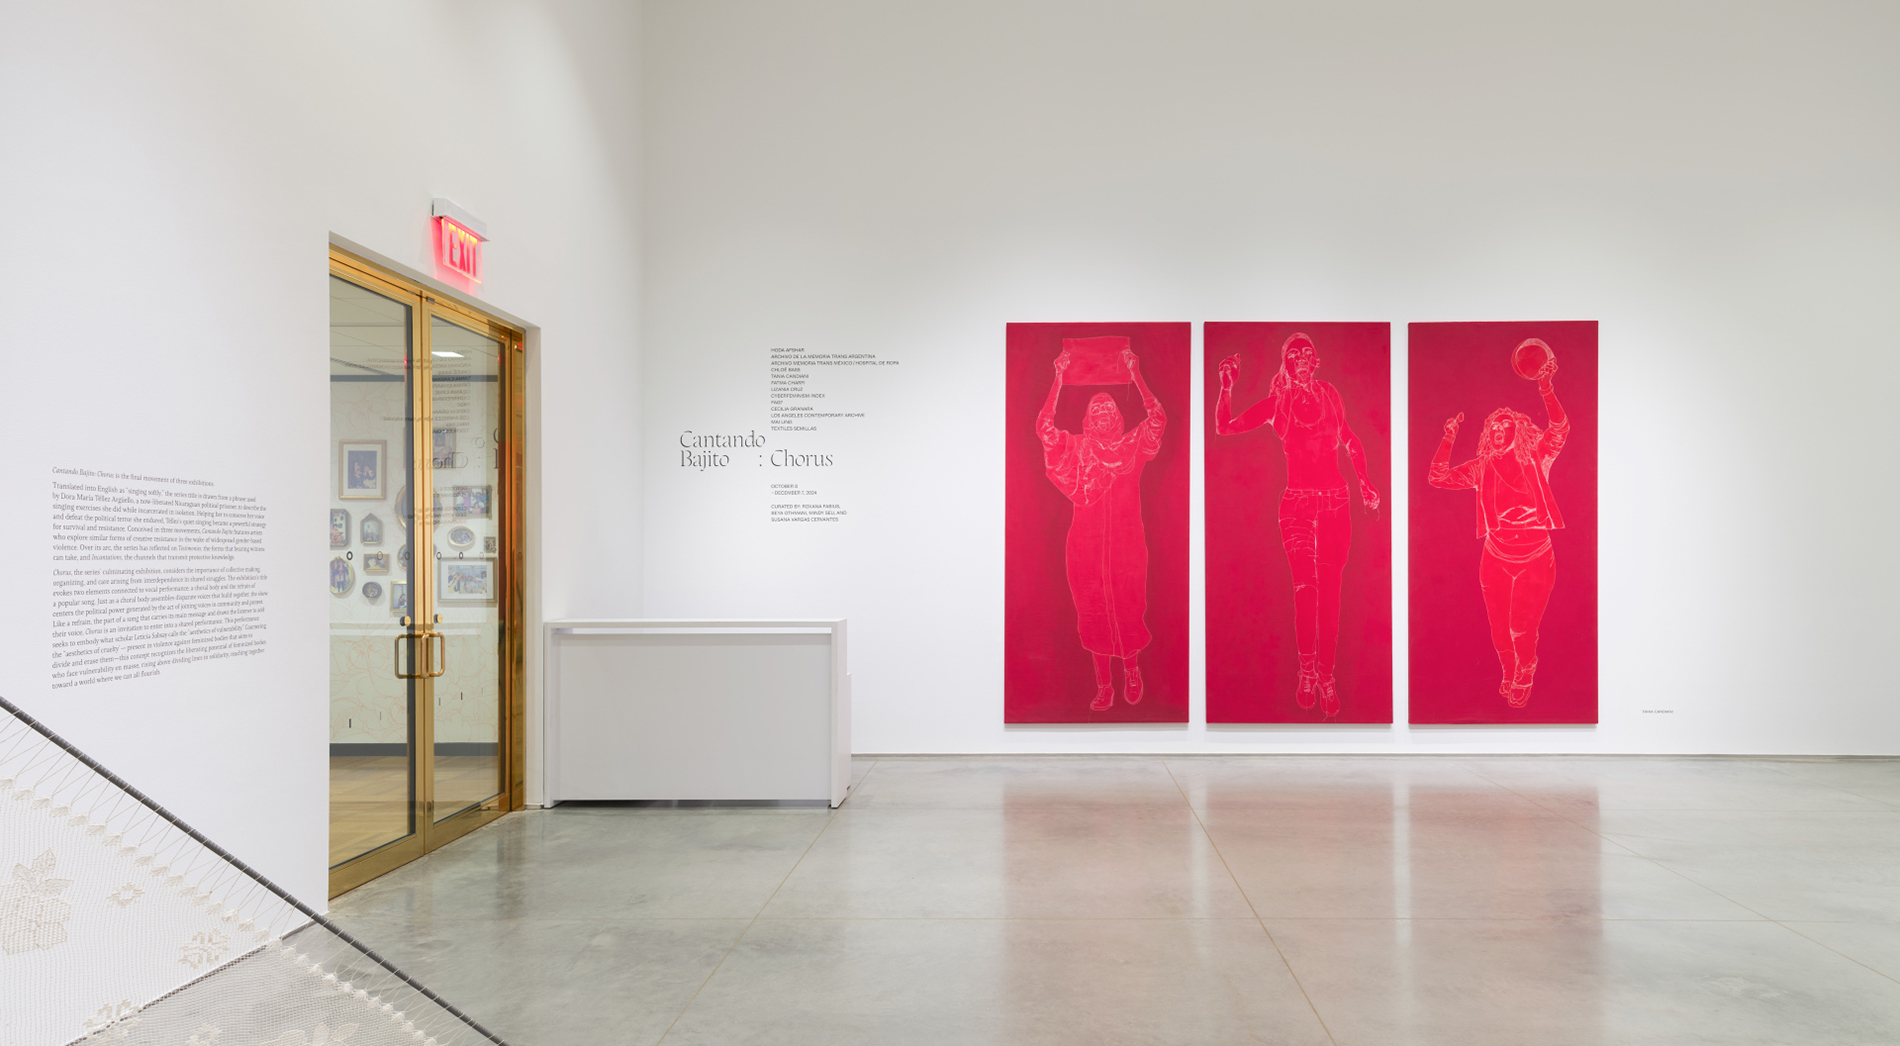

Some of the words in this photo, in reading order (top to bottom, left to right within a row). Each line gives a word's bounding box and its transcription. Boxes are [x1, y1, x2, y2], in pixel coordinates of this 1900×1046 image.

[448, 222, 478, 277] EXIT
[680, 430, 766, 448] Cantando
[681, 450, 730, 471] Bajito
[759, 455, 762, 467] :
[771, 449, 833, 467] Chorus
[52, 466, 77, 474] Cantando
[52, 481, 82, 490] Translated
[52, 503, 74, 511] singing
[58, 600, 79, 608] popular
[85, 607, 107, 616] political
[76, 637, 98, 646] embody
[52, 660, 70, 668] divide
[79, 665, 113, 675] vulnerability
[52, 680, 72, 689] toward
